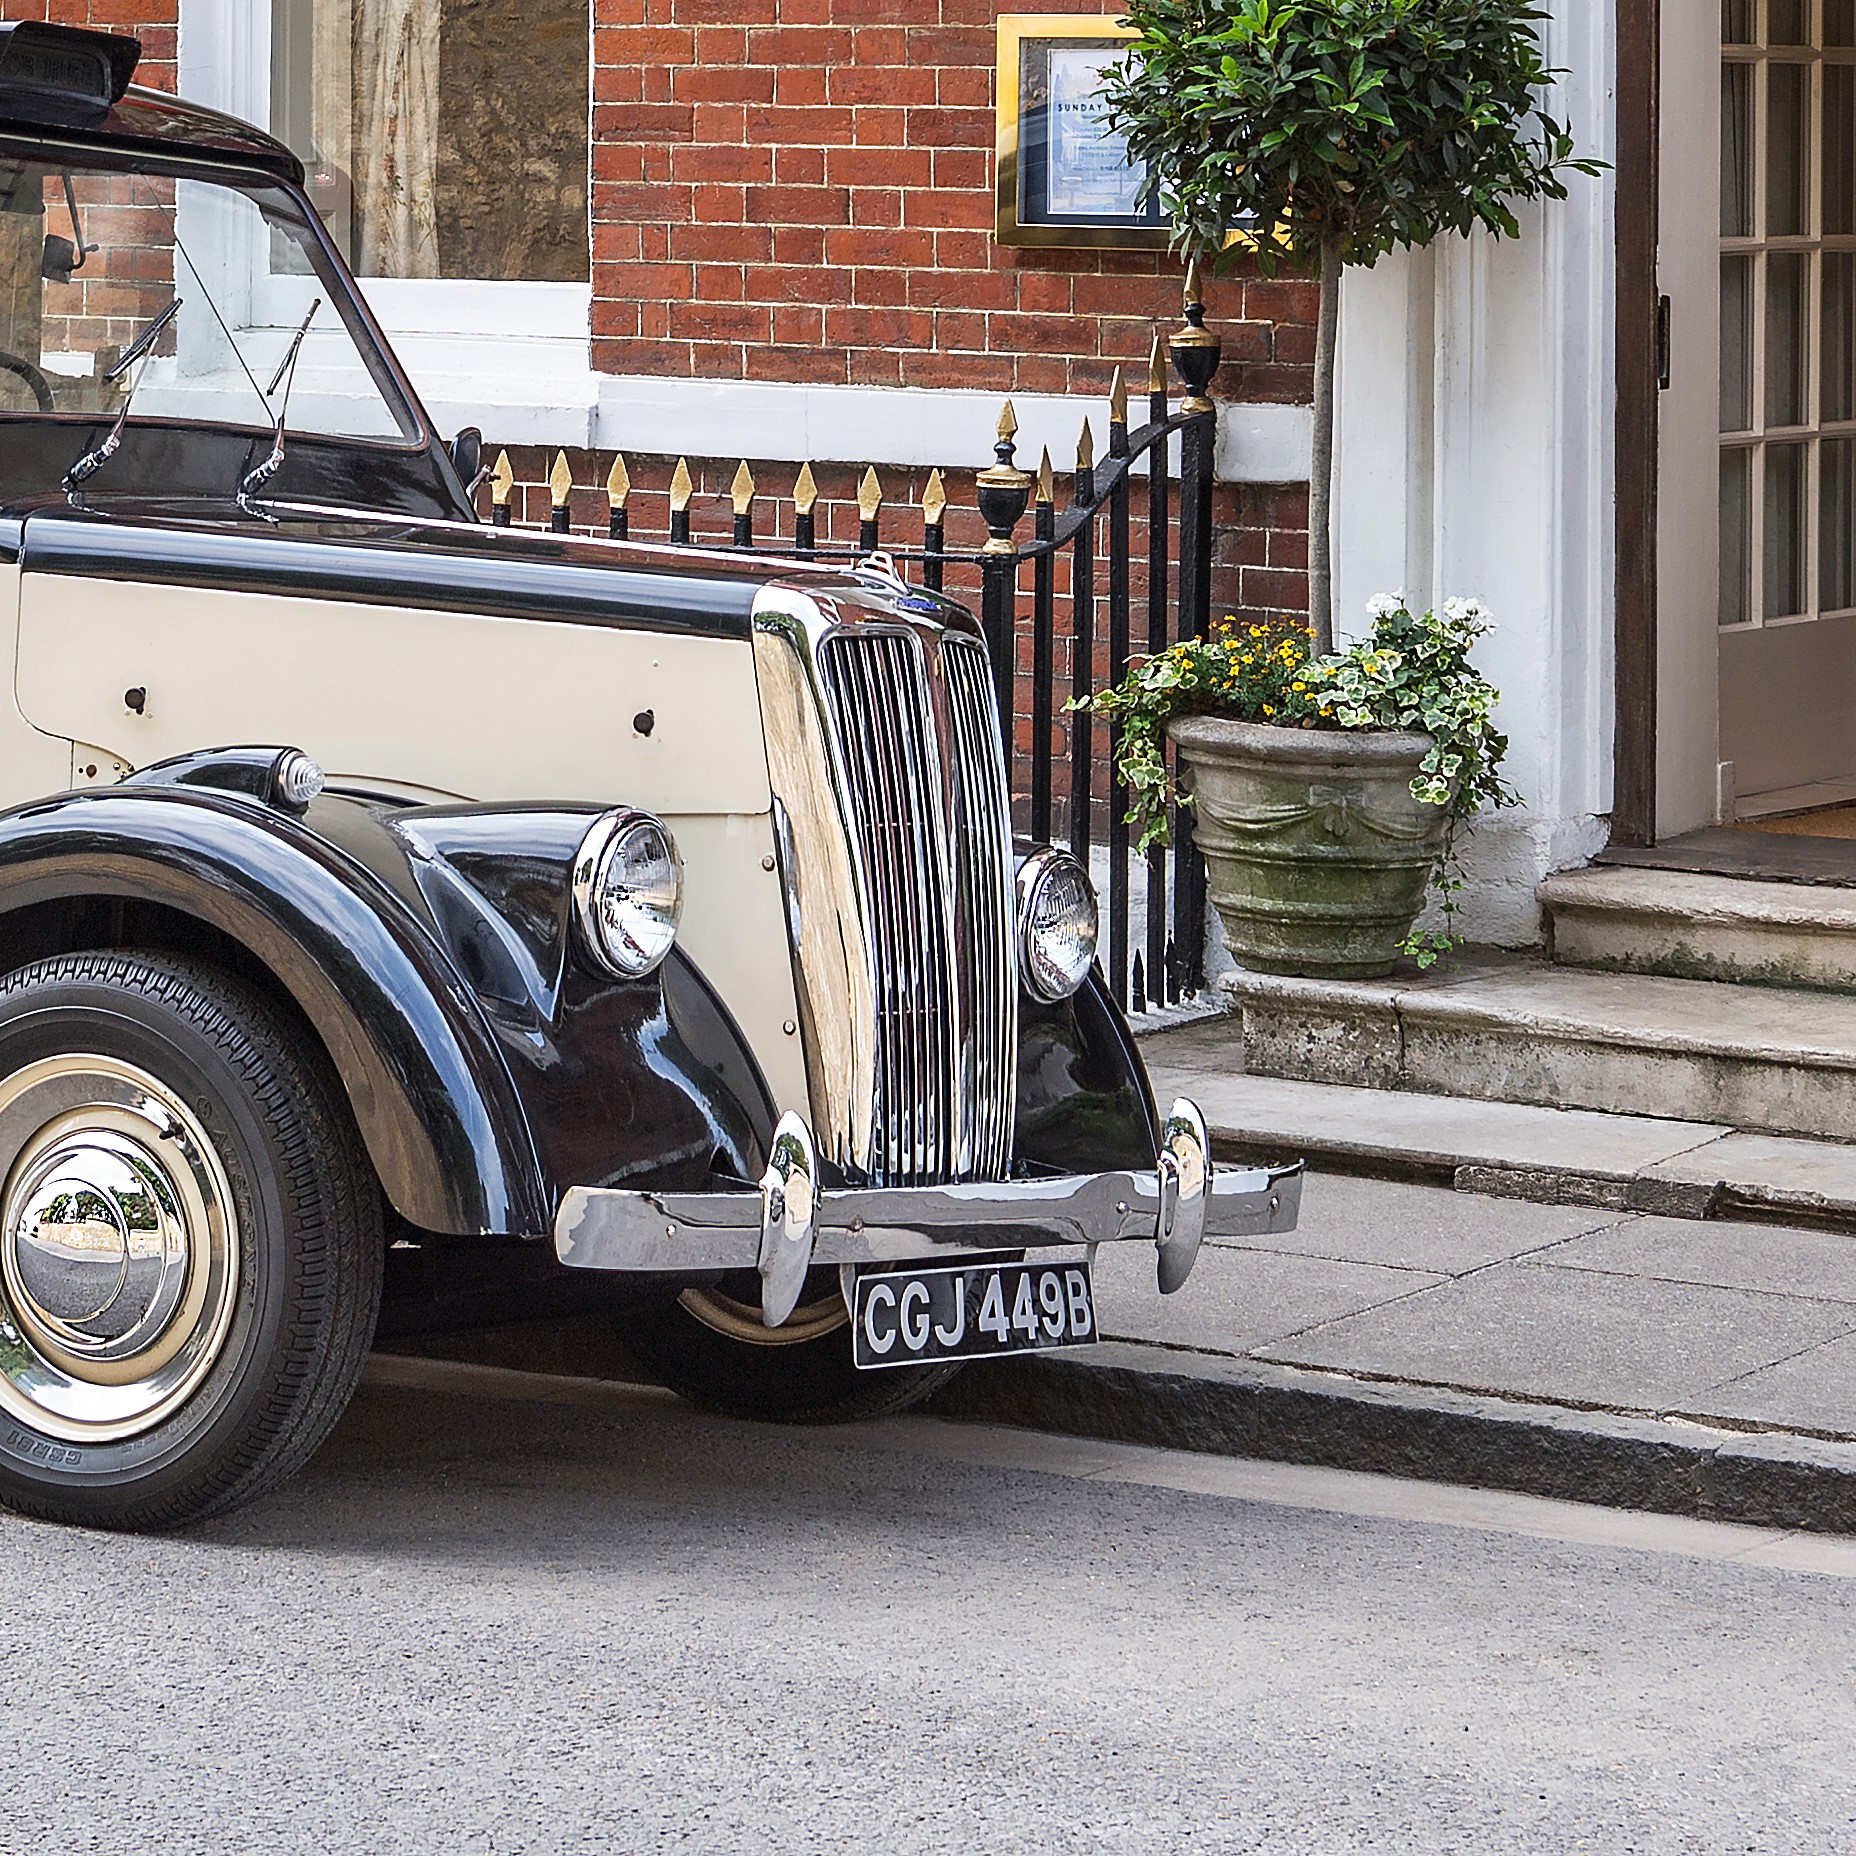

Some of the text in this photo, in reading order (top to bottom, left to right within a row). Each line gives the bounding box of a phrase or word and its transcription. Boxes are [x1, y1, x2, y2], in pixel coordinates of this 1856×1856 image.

[1057, 103, 1102, 113] SUNDAY
[864, 1269, 1092, 1355] CGJ 449B
